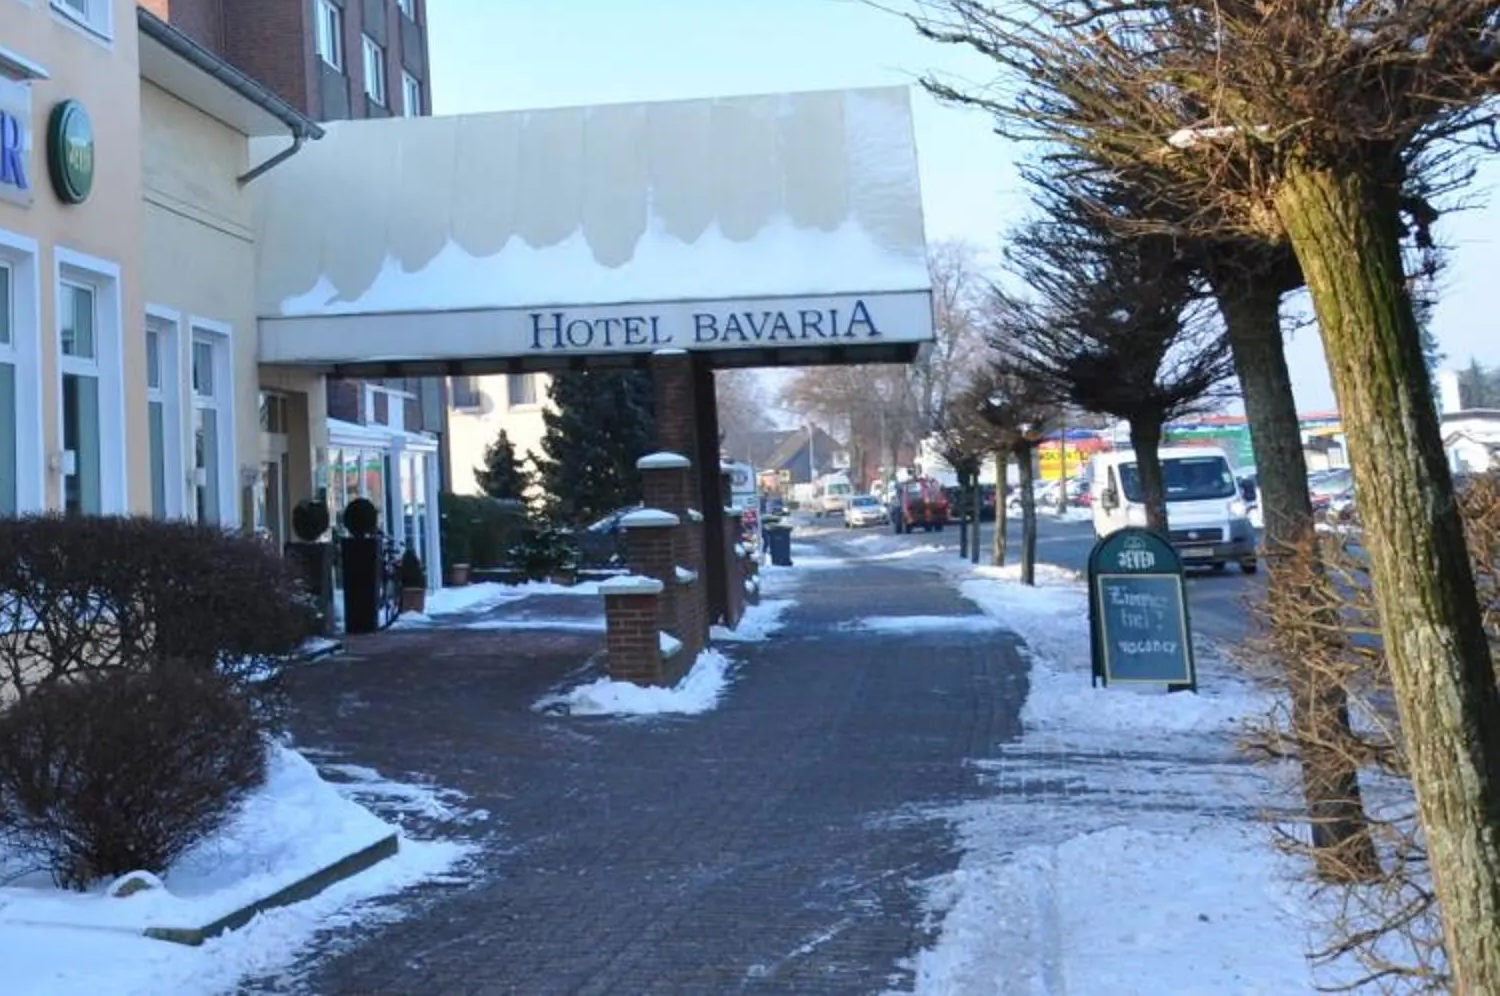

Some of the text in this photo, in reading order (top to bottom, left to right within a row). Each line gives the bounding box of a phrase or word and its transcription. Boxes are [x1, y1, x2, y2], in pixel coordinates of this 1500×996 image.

[529, 299, 882, 349] HOTEL BAVARIA
[1118, 551, 1155, 569] JEVER
